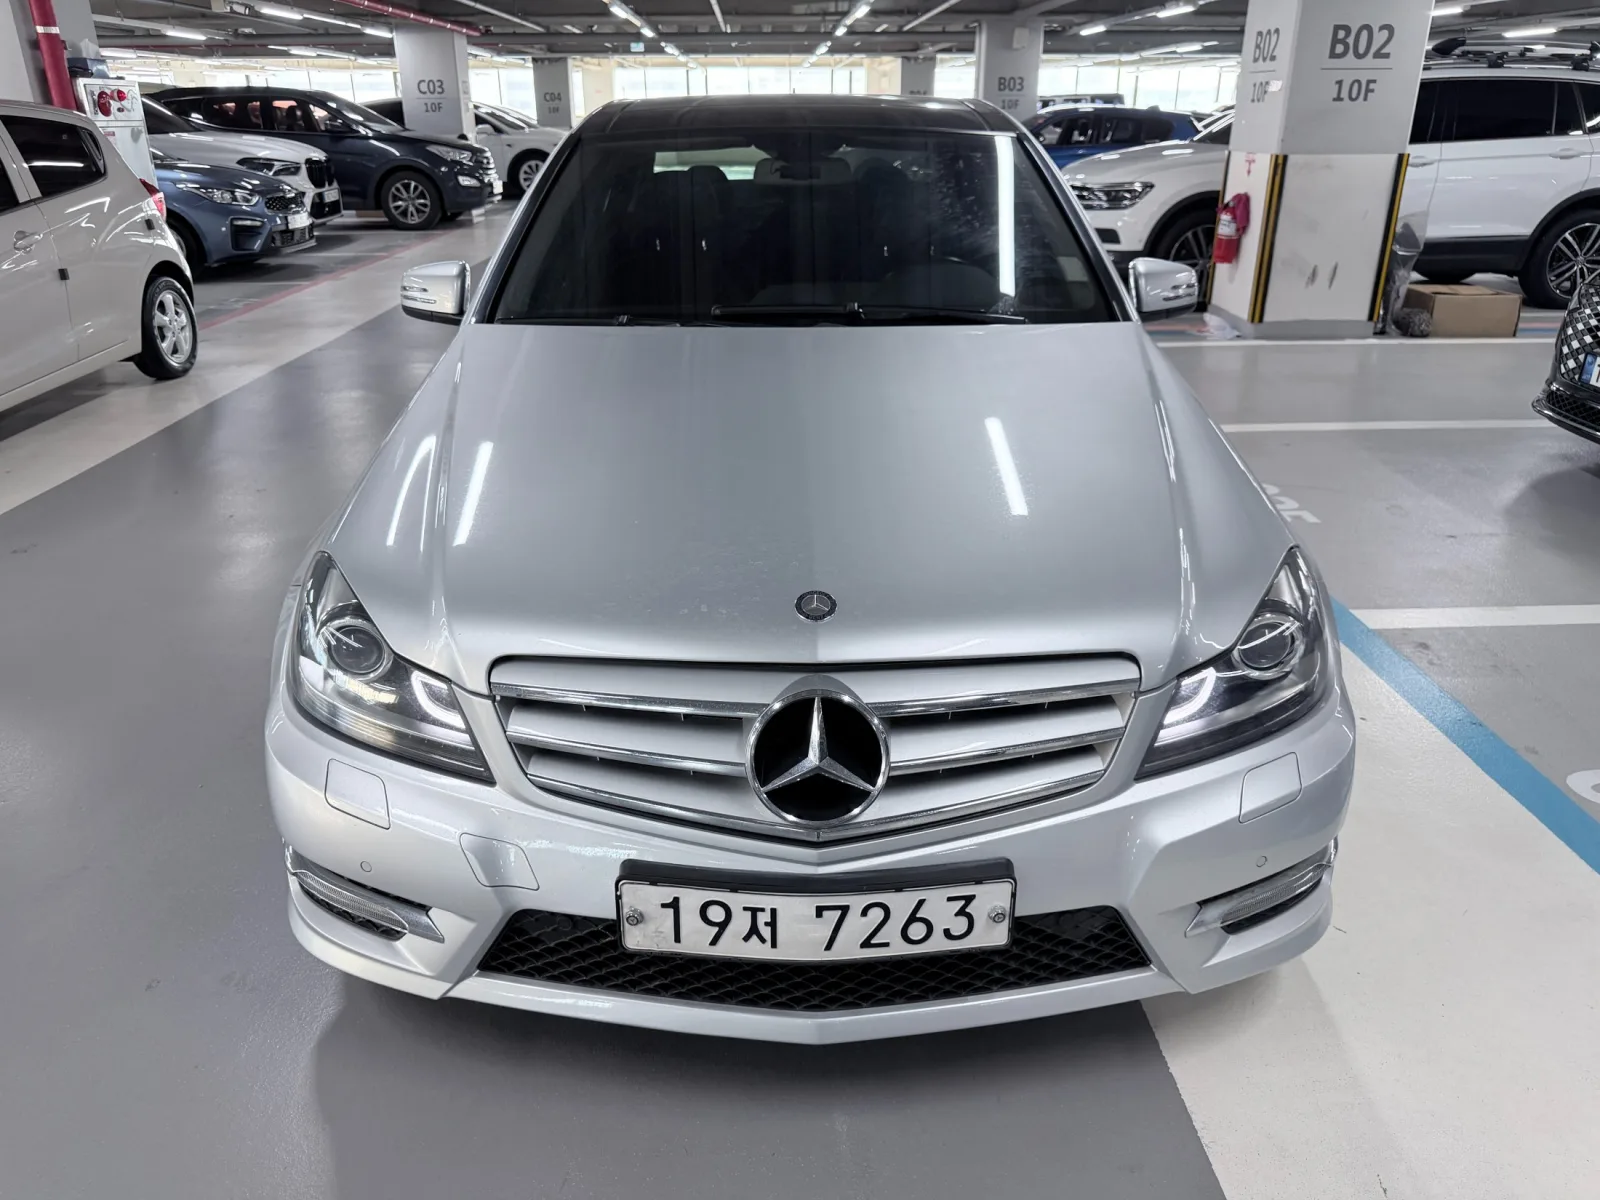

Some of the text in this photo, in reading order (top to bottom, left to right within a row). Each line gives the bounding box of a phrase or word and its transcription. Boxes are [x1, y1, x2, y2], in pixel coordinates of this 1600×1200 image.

[1252, 27, 1280, 63] B02
[1327, 23, 1395, 60] B02
[417, 79, 445, 95] C03
[997, 76, 1024, 92] B03
[1331, 78, 1377, 102] 10F
[543, 92, 562, 103] C04
[1001, 99, 1019, 110] 10F
[424, 102, 443, 113] 10F
[660, 894, 976, 952] 19저 7263
